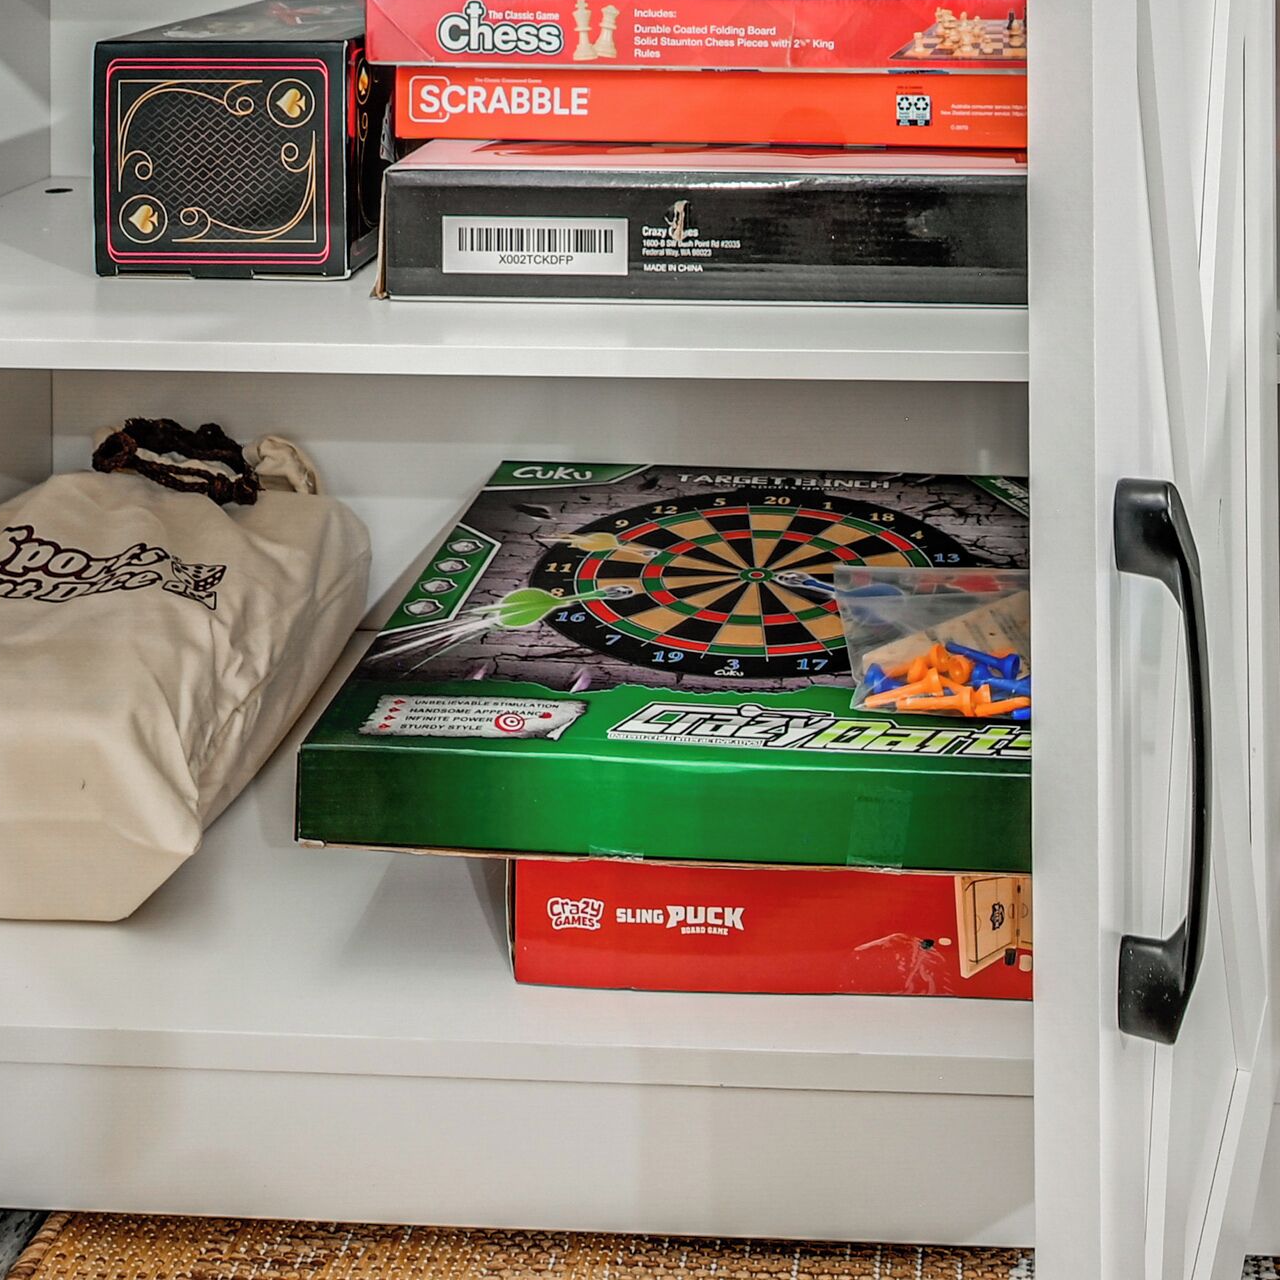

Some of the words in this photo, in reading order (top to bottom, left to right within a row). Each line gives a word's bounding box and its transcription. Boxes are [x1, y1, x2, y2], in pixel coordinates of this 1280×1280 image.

[488, 10, 503, 19] The
[505, 10, 534, 20] Classic
[536, 11, 559, 20] Game
[634, 9, 677, 18] Includes:
[438, 0, 563, 55] Chess
[634, 24, 670, 34] Durable
[673, 25, 707, 34] Coated
[710, 25, 745, 36] Folding
[747, 26, 776, 35] Board
[634, 37, 658, 46] Solid
[660, 37, 703, 47] Staunton
[705, 38, 735, 47] Chess
[737, 39, 769, 48] Pieces
[771, 38, 792, 48] with
[812, 39, 835, 50] King
[634, 49, 660, 58] Rules
[420, 84, 589, 116] SCRABBLE
[642, 226, 667, 238] Crazy
[642, 248, 665, 256] Federal
[499, 254, 573, 265] X002TCKDFP
[643, 264, 666, 272] MADE
[668, 264, 677, 272] IN
[678, 264, 703, 272] CHINA
[677, 473, 784, 486] TARGET
[821, 478, 890, 489] INCH
[714, 497, 726, 507] 5
[763, 496, 791, 506] 20
[652, 505, 677, 515] 12
[870, 512, 894, 522] 18
[615, 520, 629, 528] 9
[934, 553, 960, 563] 13
[545, 562, 571, 572] 11
[34, 570, 163, 604] Dice
[555, 612, 586, 622] 16
[605, 634, 621, 645] 7
[651, 651, 684, 663] 19
[796, 658, 829, 670] 17
[414, 699, 490, 707] UNBELIEVABLE
[493, 701, 559, 709] STIMULATION
[548, 898, 603, 918] Crazy
[554, 917, 600, 928] GAMES
[616, 907, 664, 924] SLING
[666, 905, 744, 931] PUCK
[681, 926, 706, 935] BOARD
[707, 927, 729, 936] GAME
